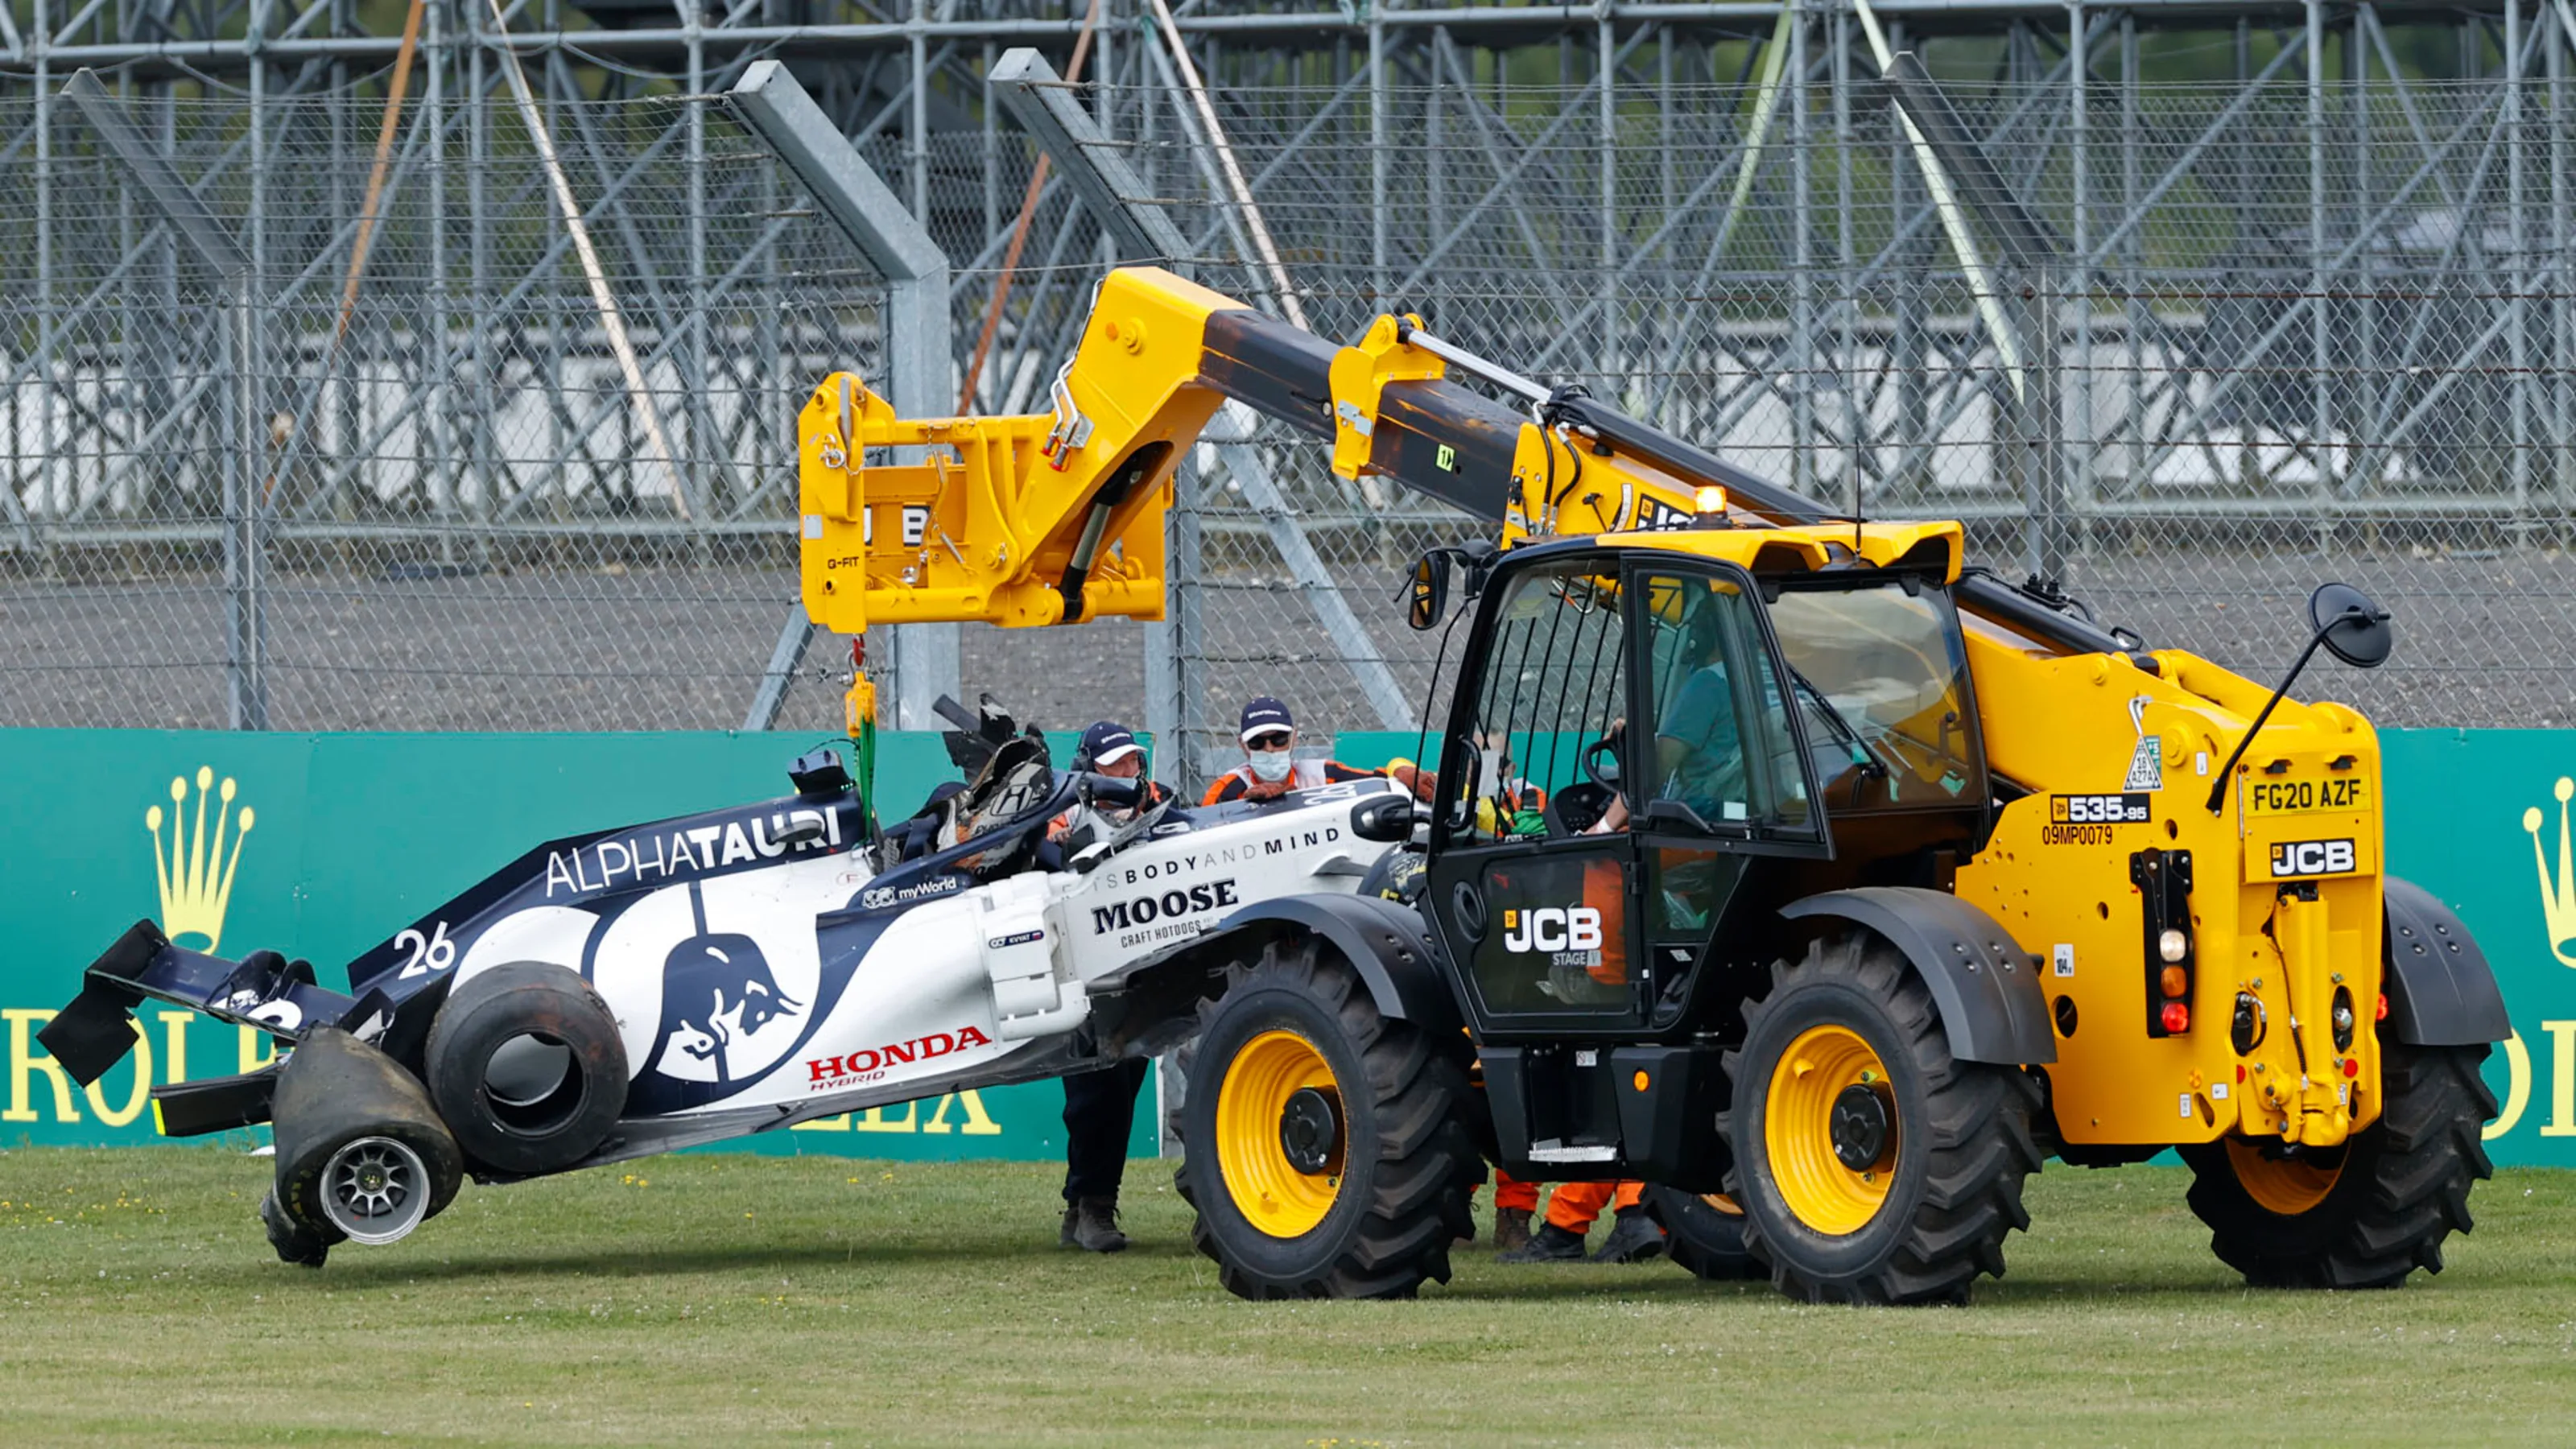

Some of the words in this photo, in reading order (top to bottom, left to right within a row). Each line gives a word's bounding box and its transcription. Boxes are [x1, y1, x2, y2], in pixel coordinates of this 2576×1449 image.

[2254, 782, 2312, 811] FG20
[2320, 779, 2360, 807] AZF
[2042, 825, 2113, 845] 09MP0079
[546, 807, 842, 898] ALPHATAURI
[2272, 840, 2355, 876] JCB
[898, 877, 956, 900] myWorld
[1092, 877, 1239, 935] MOOSE
[1121, 930, 1152, 949] CRAFT
[1154, 919, 1202, 940] HOTDOGS
[1505, 907, 1602, 952] JCB
[394, 920, 456, 980] 26
[1552, 952, 1586, 966] STAGE
[806, 1026, 993, 1082] HONDA
[810, 1071, 886, 1092] HYBRID
